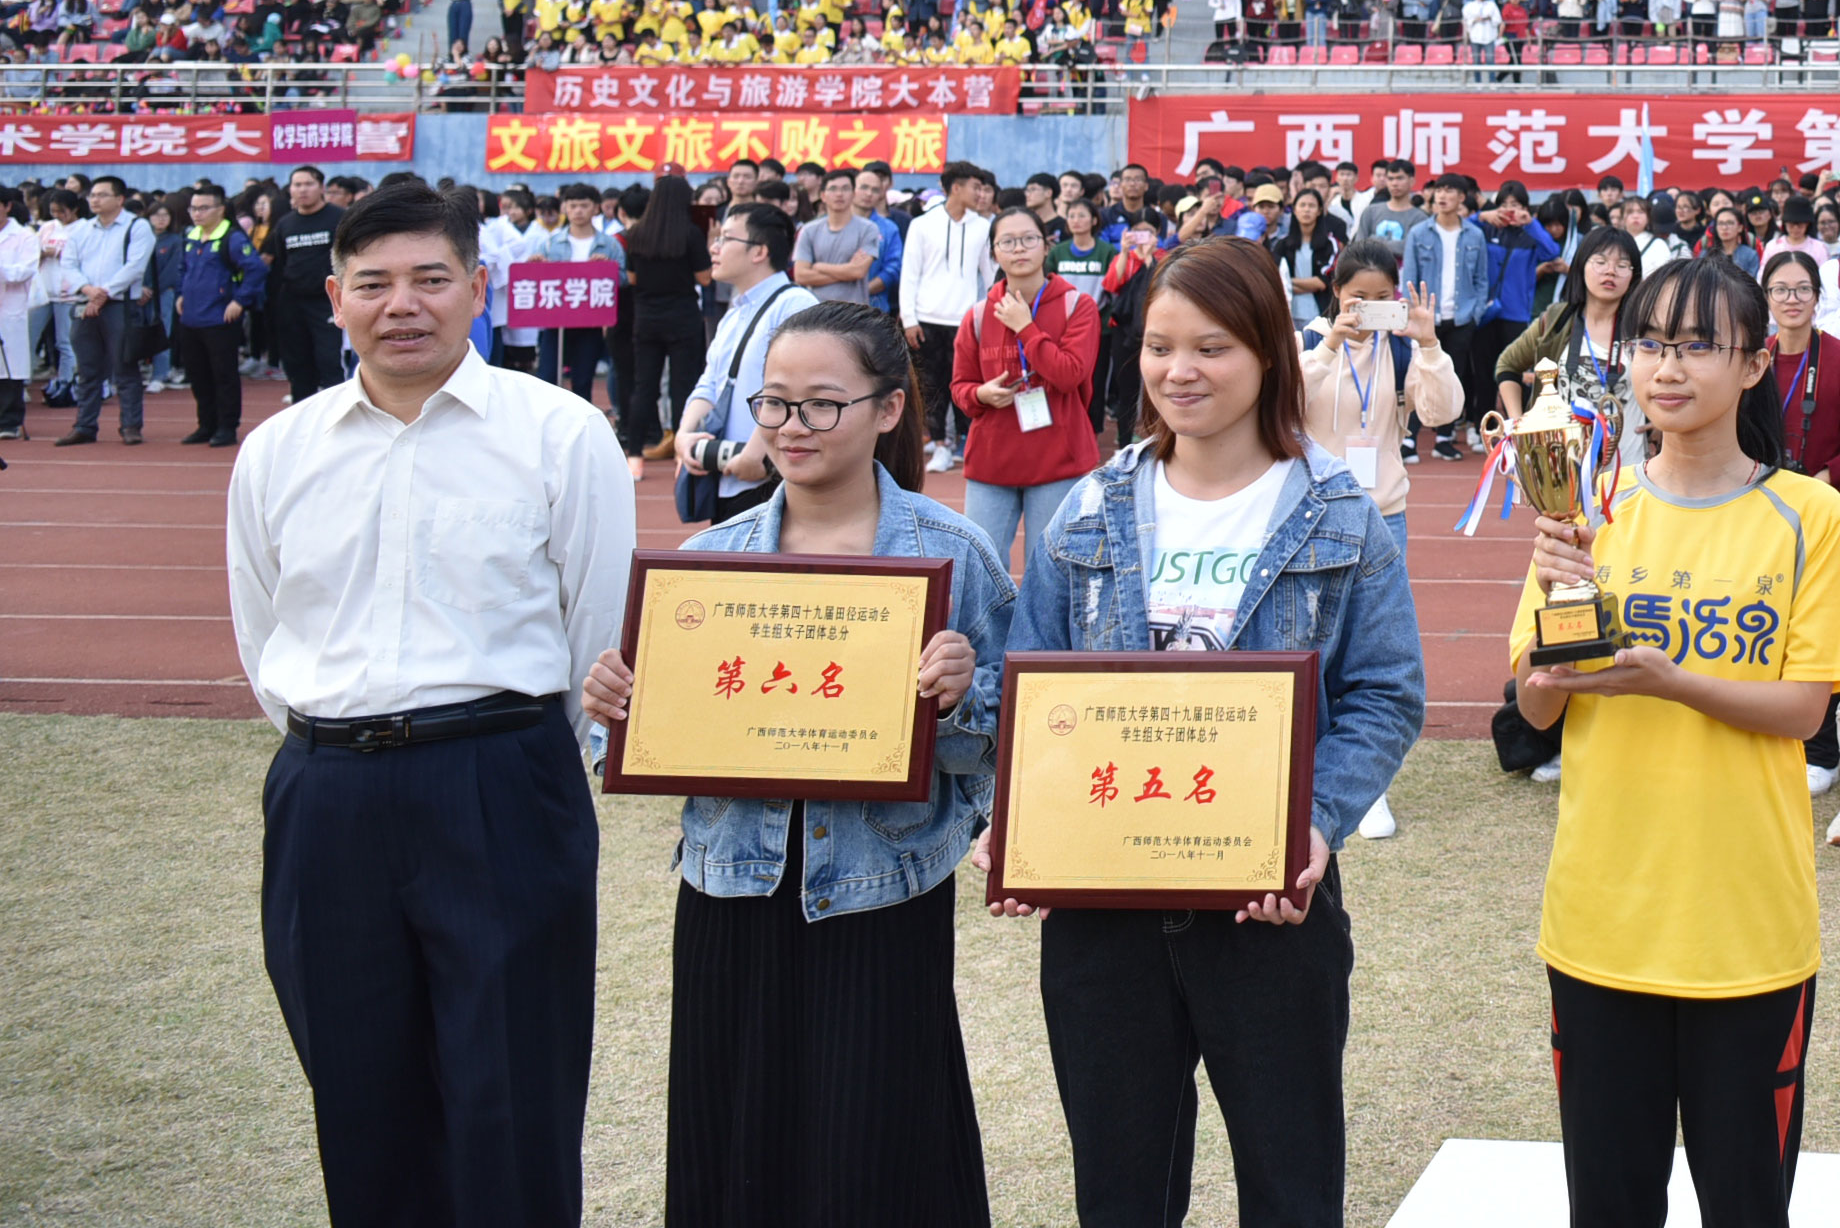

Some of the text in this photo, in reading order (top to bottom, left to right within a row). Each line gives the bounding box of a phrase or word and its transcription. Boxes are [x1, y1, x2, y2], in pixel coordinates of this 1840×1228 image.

[553, 74, 995, 108] 历史文化与旅游学院大本营
[0, 122, 409, 156] 术学院大营
[273, 122, 354, 150] 化学与药学学院
[488, 115, 947, 172] 文旅文旅不败之旅
[512, 277, 616, 310] 音乐学院
[713, 601, 890, 623] 广西师范大学第四十九届田径运动会
[750, 624, 849, 641] 学生组女子团体总分
[713, 655, 846, 701] 第六名
[1084, 705, 1258, 724] 广西师范大学第四十九届田径运动会
[746, 726, 879, 741] 广西师范大学体育运动委员会
[1120, 725, 1219, 743] 学生组女子团体总分
[1088, 760, 1217, 808] 第五名
[1122, 835, 1252, 848] 广西师范大学体育运动委员会
